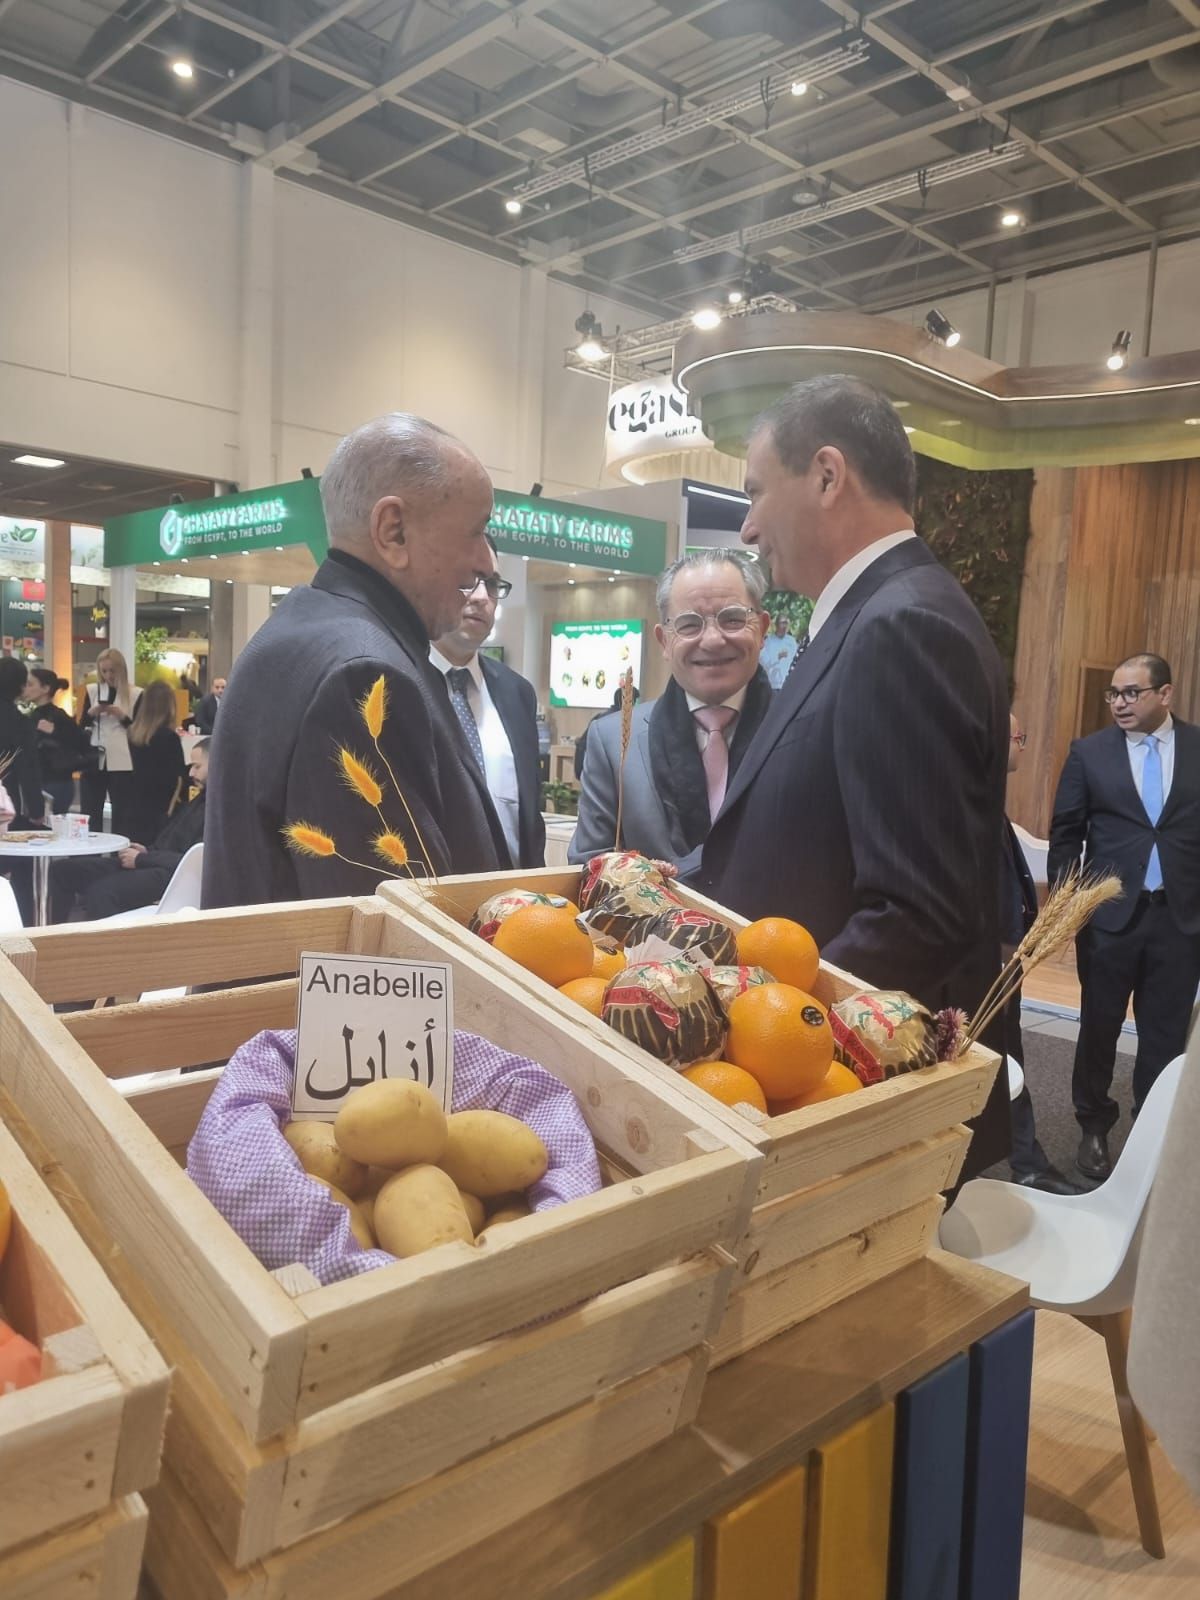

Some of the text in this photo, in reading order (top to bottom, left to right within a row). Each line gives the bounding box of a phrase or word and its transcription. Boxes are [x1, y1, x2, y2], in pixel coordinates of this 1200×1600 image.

[665, 425, 697, 438] GROUP
[184, 536, 202, 545] FROM
[228, 530, 238, 540] TO
[239, 528, 254, 538] THE
[255, 522, 283, 536] WORLD
[512, 530, 550, 547] EGYPT,
[554, 537, 567, 548] TO
[570, 540, 591, 552] THE
[594, 544, 630, 559] WORLD
[571, 518, 633, 548] FARMS
[306, 965, 444, 999] Anabelle
